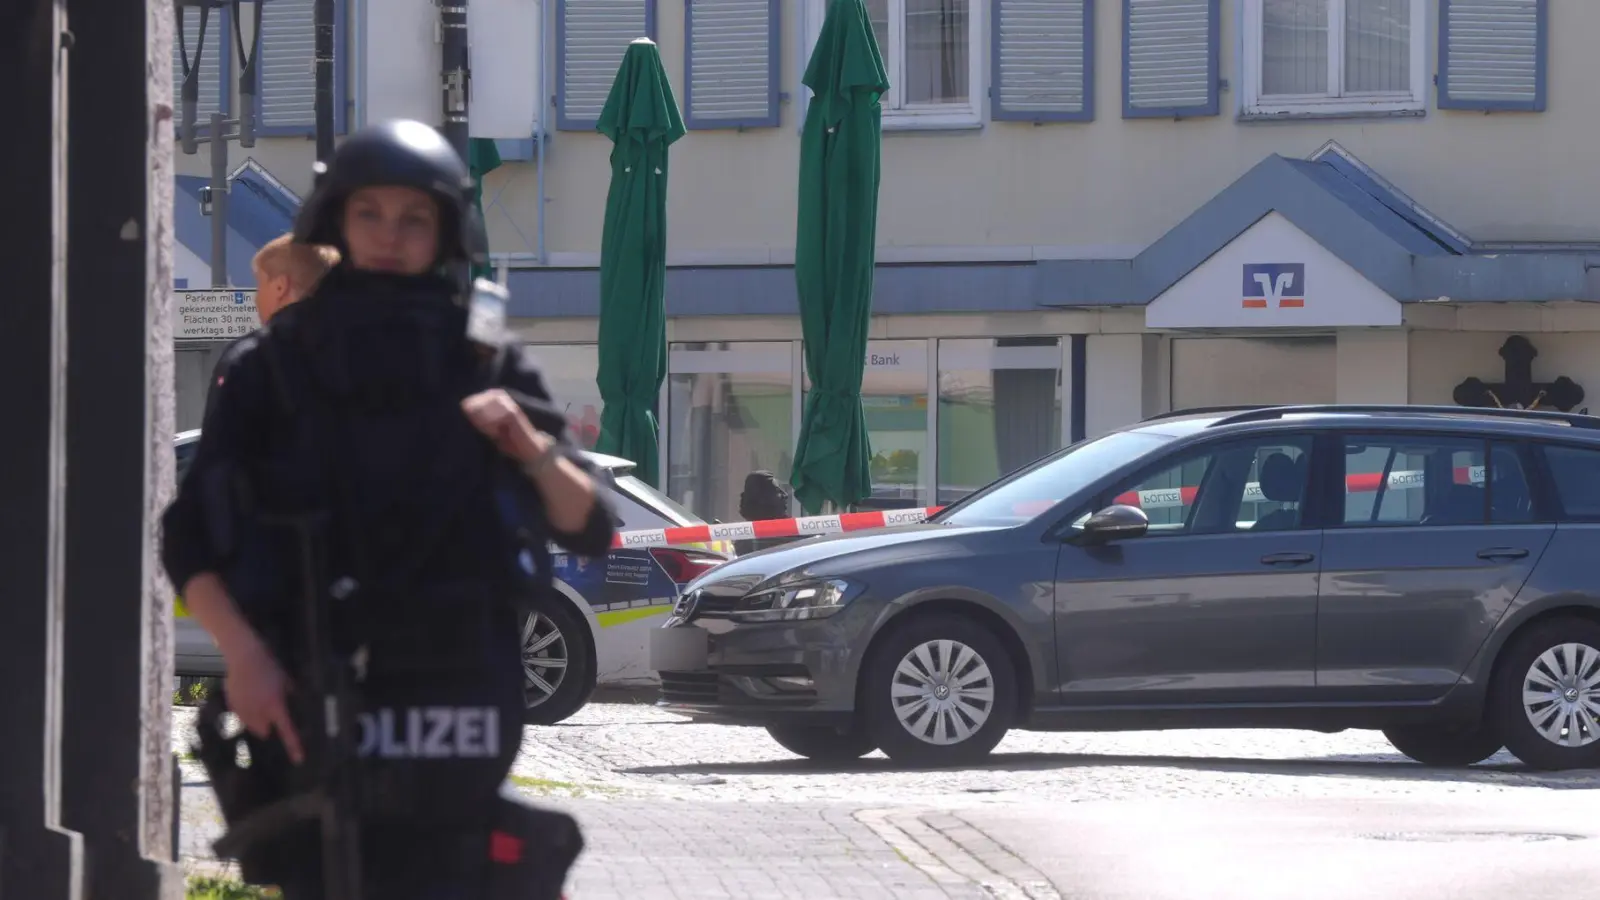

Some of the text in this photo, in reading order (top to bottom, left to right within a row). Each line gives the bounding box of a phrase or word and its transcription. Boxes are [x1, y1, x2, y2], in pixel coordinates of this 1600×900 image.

[185, 294, 217, 302] Parken
[220, 294, 234, 302] mit
[179, 304, 258, 315] gekennzeichneten
[183, 315, 218, 324] Flächen
[221, 315, 232, 323] 30
[183, 326, 224, 336] werktags
[227, 326, 246, 334] 8-18
[871, 351, 900, 366] Bank
